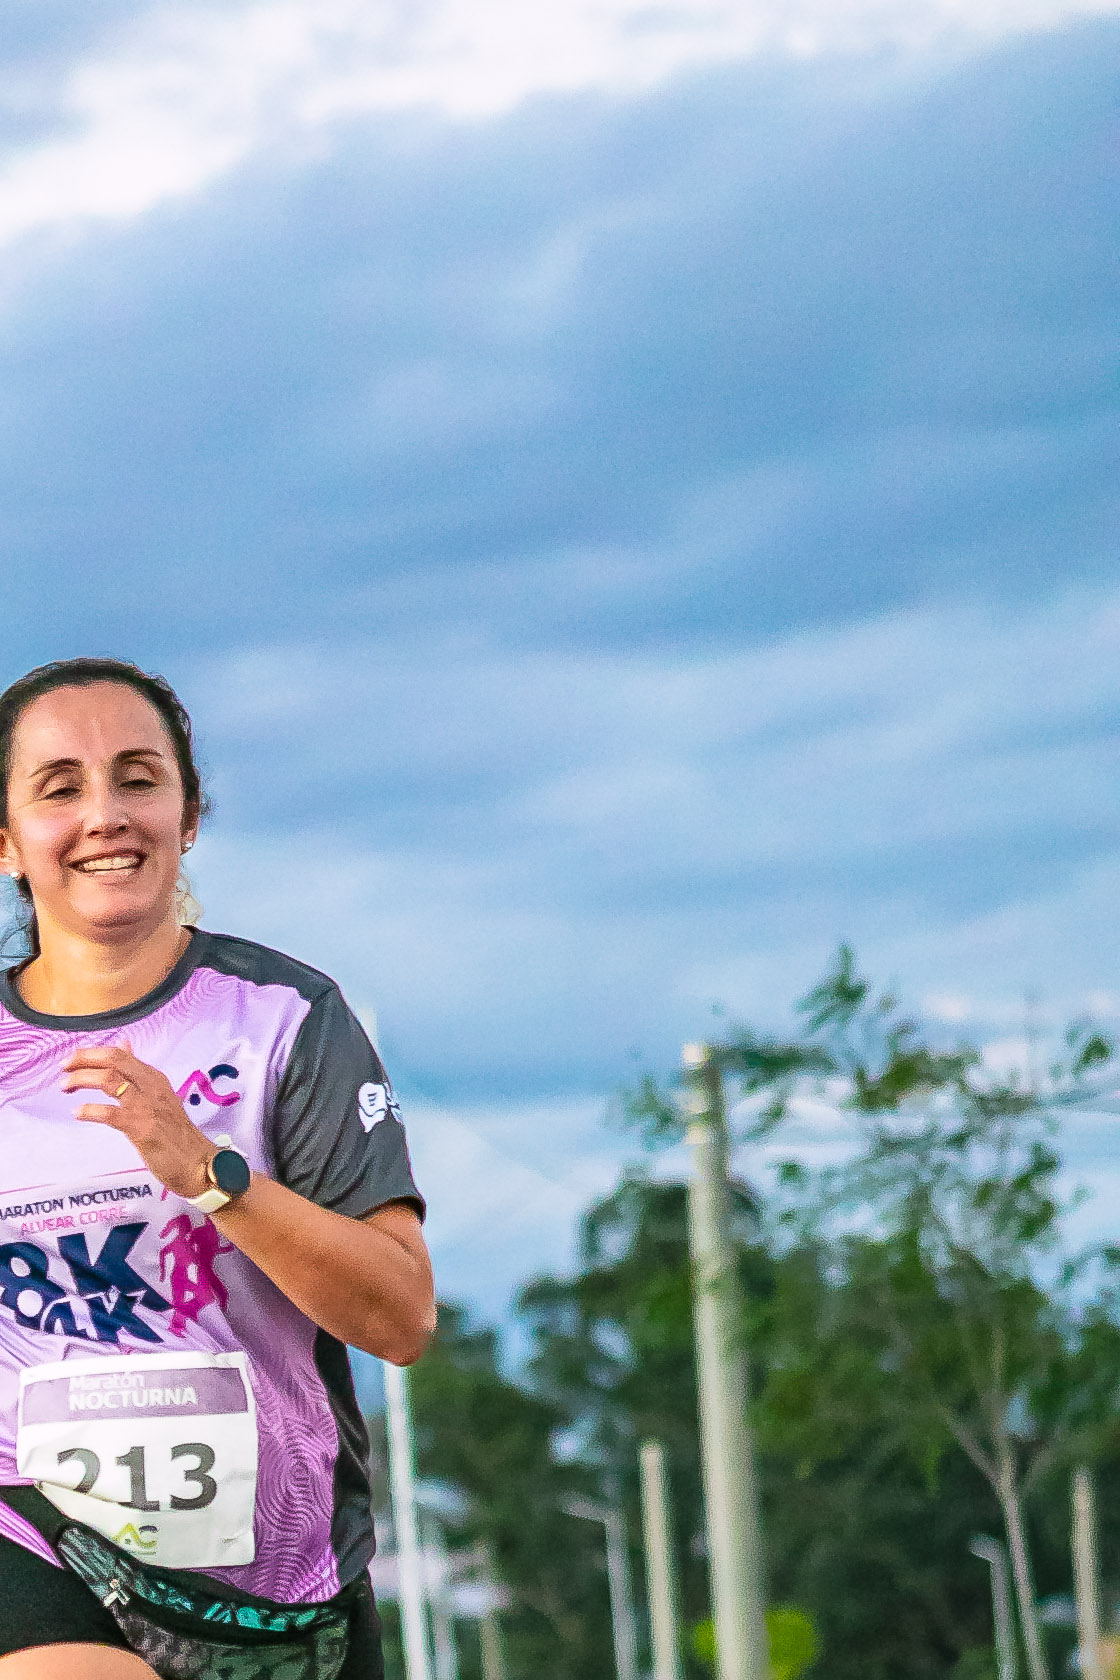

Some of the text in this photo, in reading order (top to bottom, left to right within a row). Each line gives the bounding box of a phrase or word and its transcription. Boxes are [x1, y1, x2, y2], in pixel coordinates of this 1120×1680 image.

[68, 1184, 153, 1208] NOCTURNA
[69, 1386, 199, 1412] NOCTURNA
[57, 1442, 218, 1512] 213
